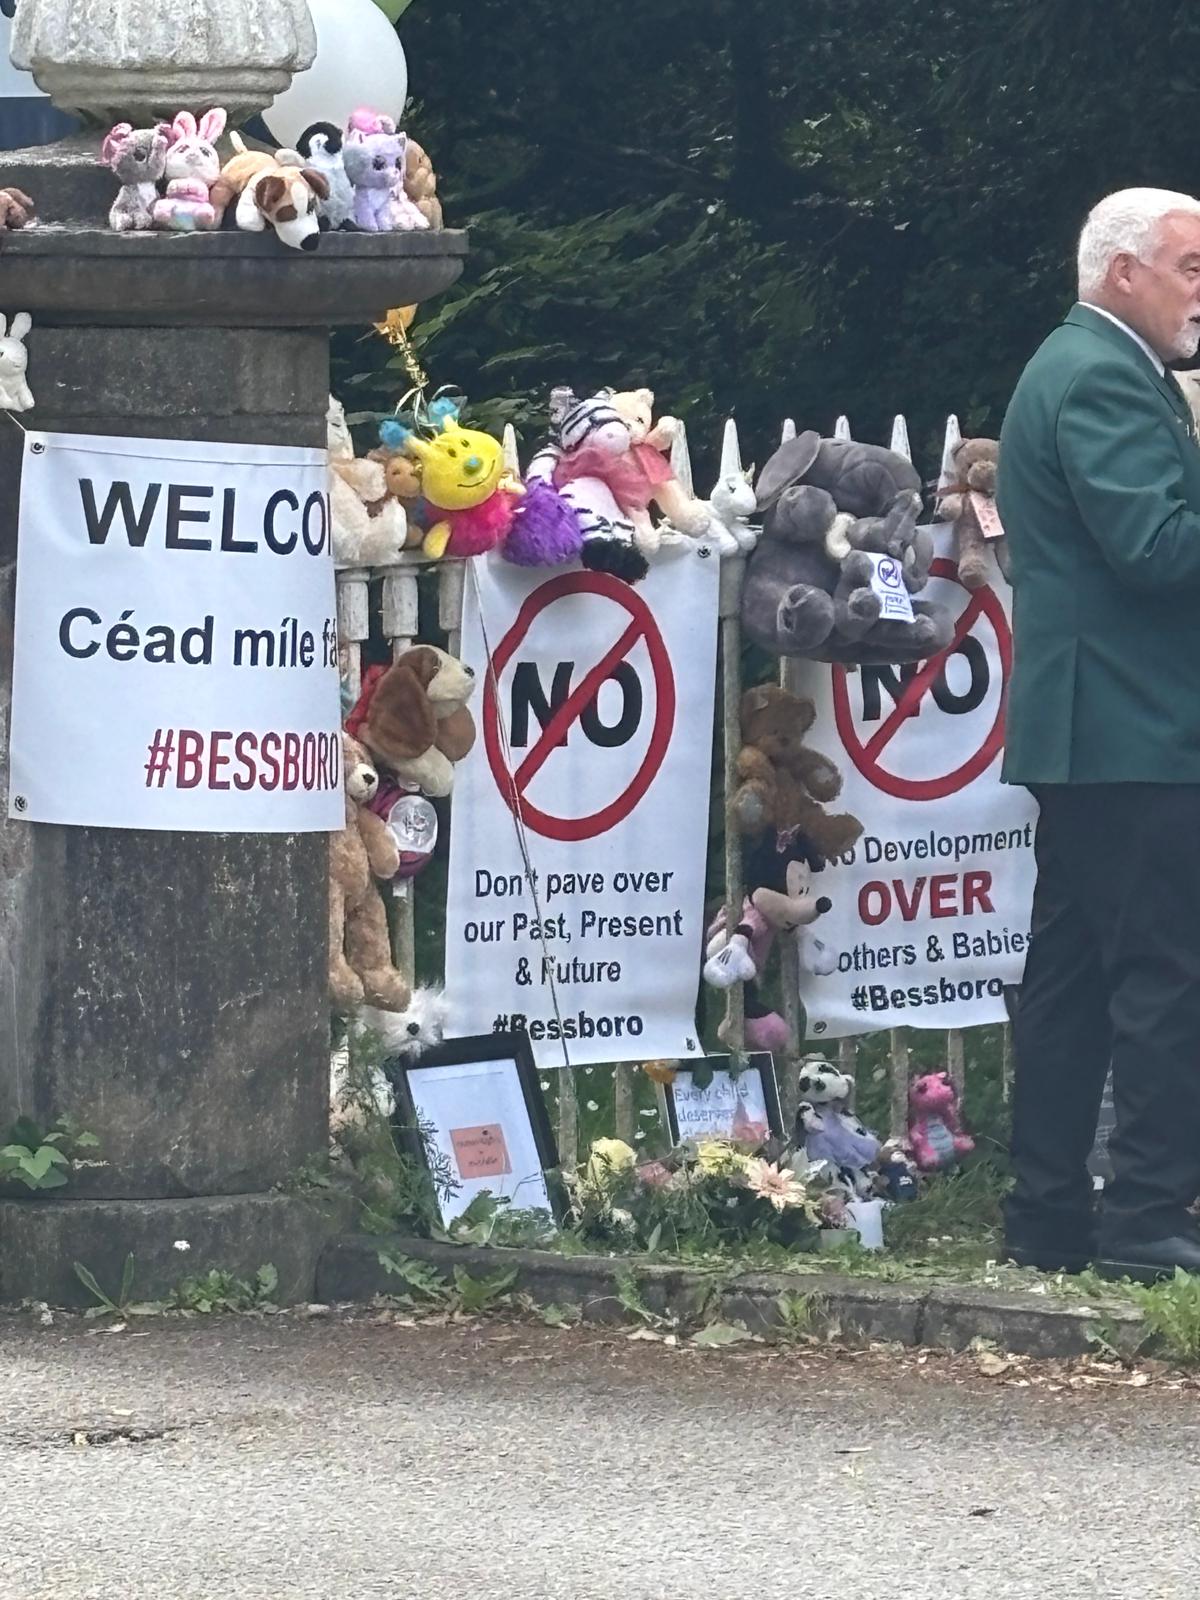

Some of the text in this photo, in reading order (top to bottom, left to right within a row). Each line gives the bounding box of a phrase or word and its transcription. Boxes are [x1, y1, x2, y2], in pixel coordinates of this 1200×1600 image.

[78, 478, 331, 556] WELCO
[59, 607, 214, 665] Céad
[233, 618, 315, 668] míle
[861, 634, 990, 721] NO
[510, 661, 643, 748] NO
[145, 729, 339, 791] #BESSBORO
[864, 822, 1033, 864] Development
[547, 872, 604, 903] pave
[613, 870, 674, 893] over
[858, 870, 996, 926] OVER
[464, 910, 684, 943] our Past, Present
[515, 956, 622, 986] & Future
[837, 941, 917, 973] others
[926, 934, 945, 963] &
[851, 977, 1004, 1011] #Bessboro
